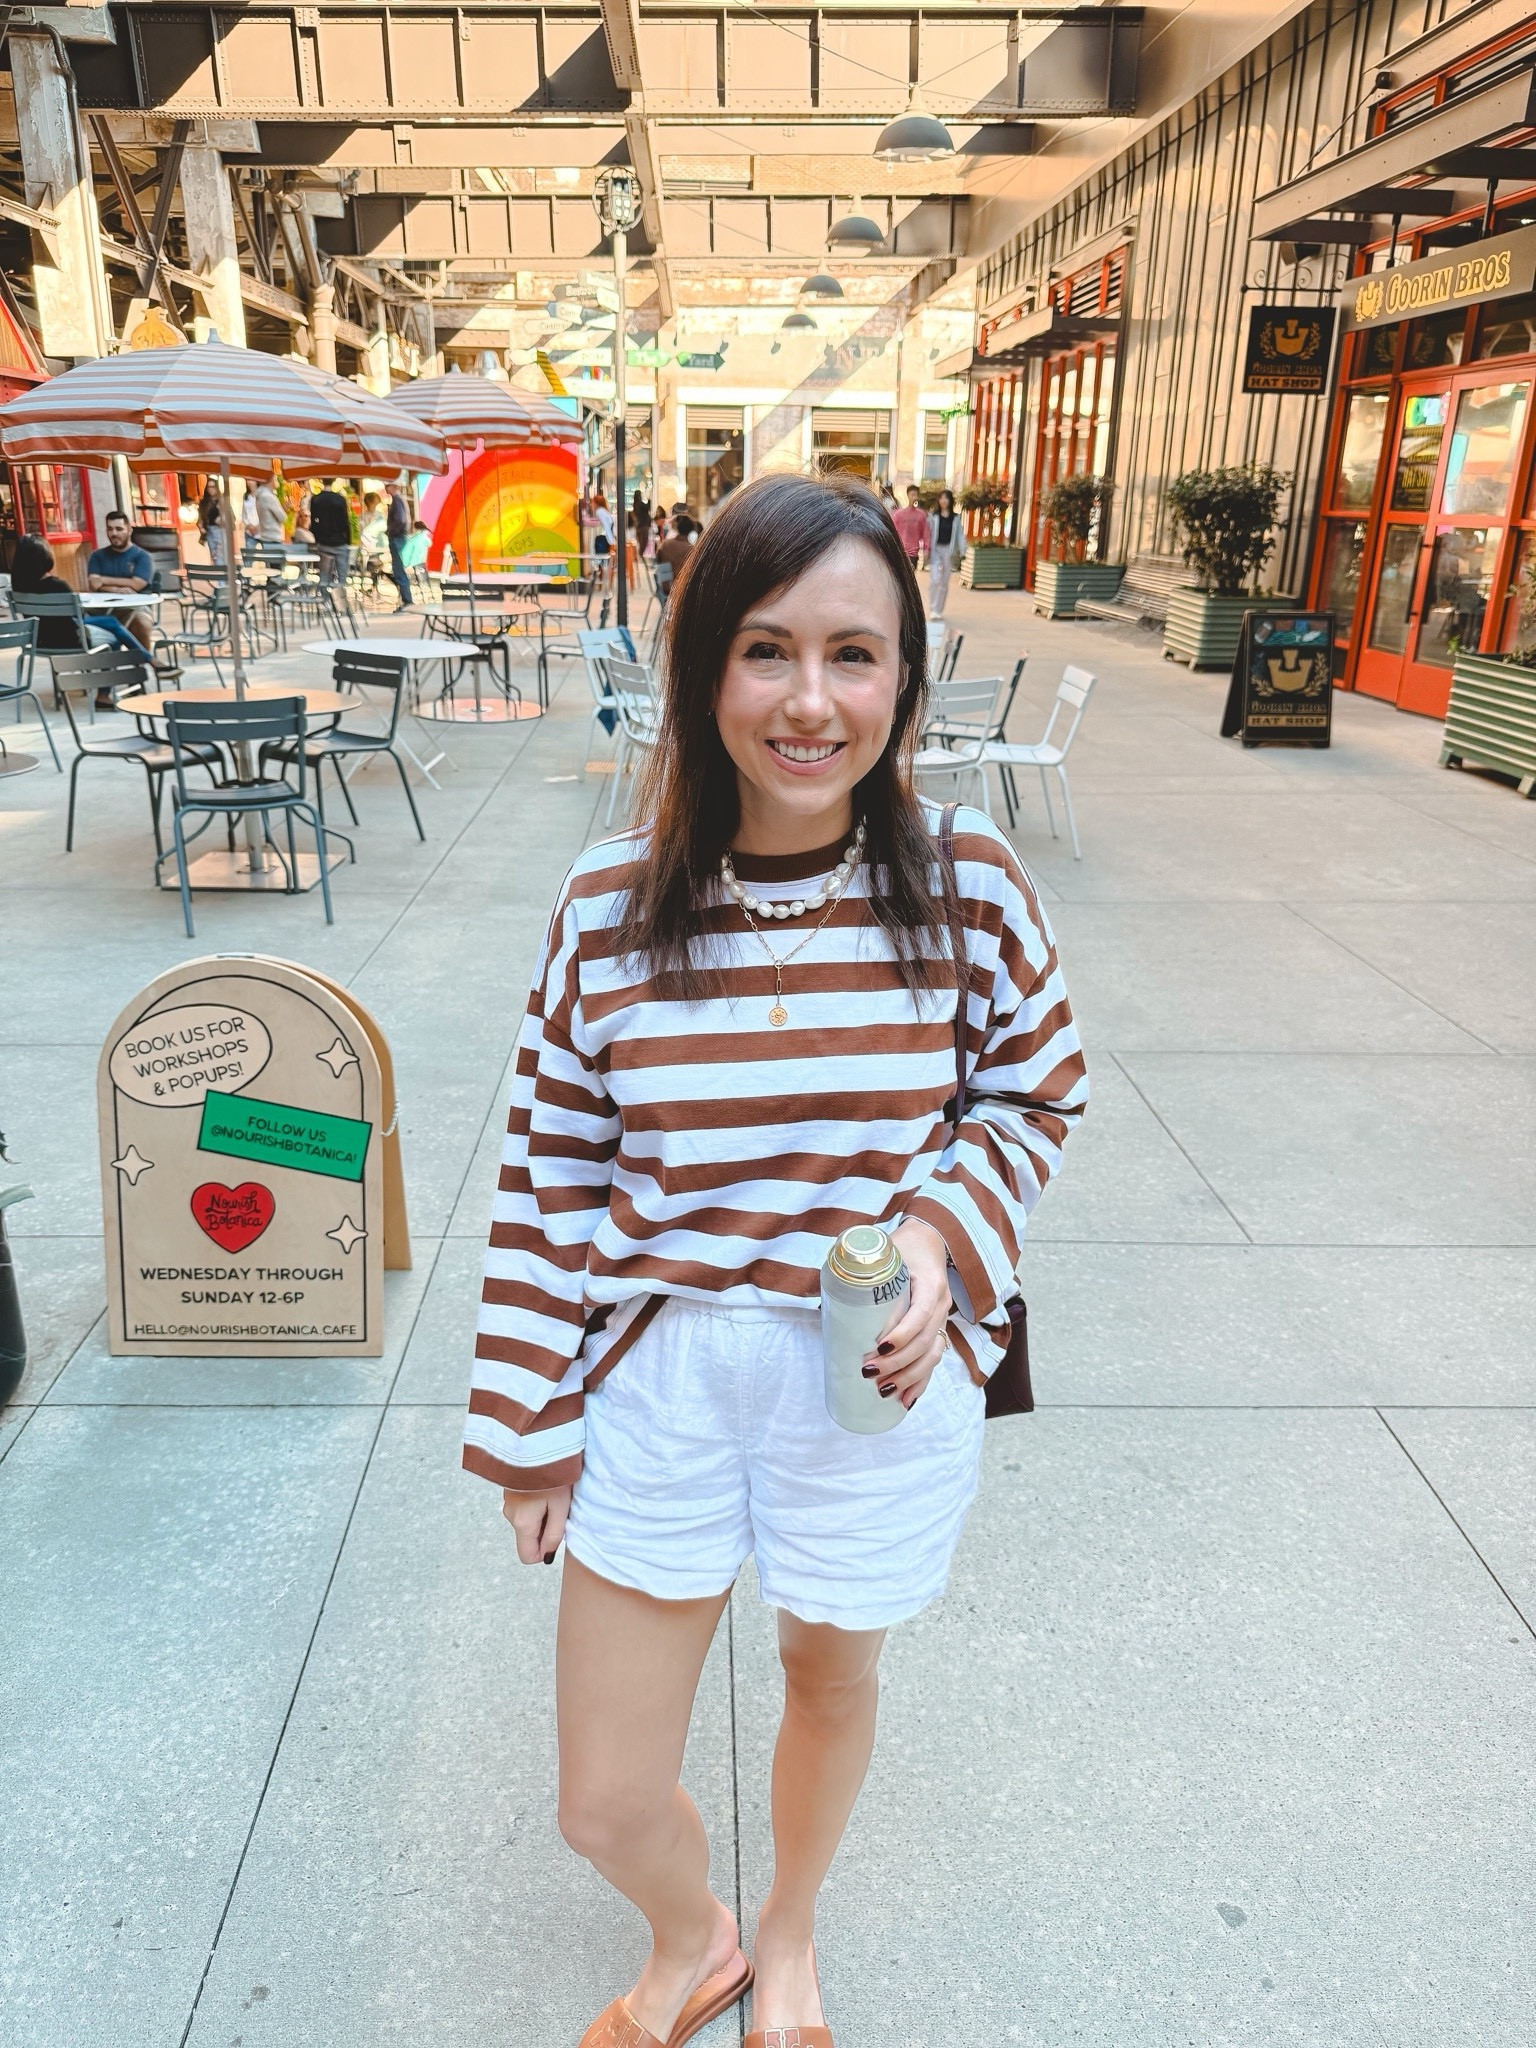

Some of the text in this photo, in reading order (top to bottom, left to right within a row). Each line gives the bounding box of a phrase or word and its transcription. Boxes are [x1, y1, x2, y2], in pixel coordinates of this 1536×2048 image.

[1385, 267, 1453, 314] GOORIN
[1251, 378, 1319, 388] HAT SHOP
[1252, 717, 1324, 725] HAT SHOP
[125, 1016, 246, 1058] BOOK US FOR
[134, 1038, 249, 1078] WORKSHOPS
[154, 1061, 244, 1096] & POPUPS!
[248, 1115, 327, 1141] FOLLOW US
[210, 1123, 358, 1164] @NOURISHBOTANICA!
[207, 1191, 260, 1213] Nourish
[206, 1211, 262, 1230] Botanica
[140, 1267, 344, 1281] WEDNESDAY THROUGH
[181, 1291, 305, 1304] SUNDAY 12-6P
[134, 1323, 357, 1336] HELLO@NOURISHBOTANICA.CAFE
